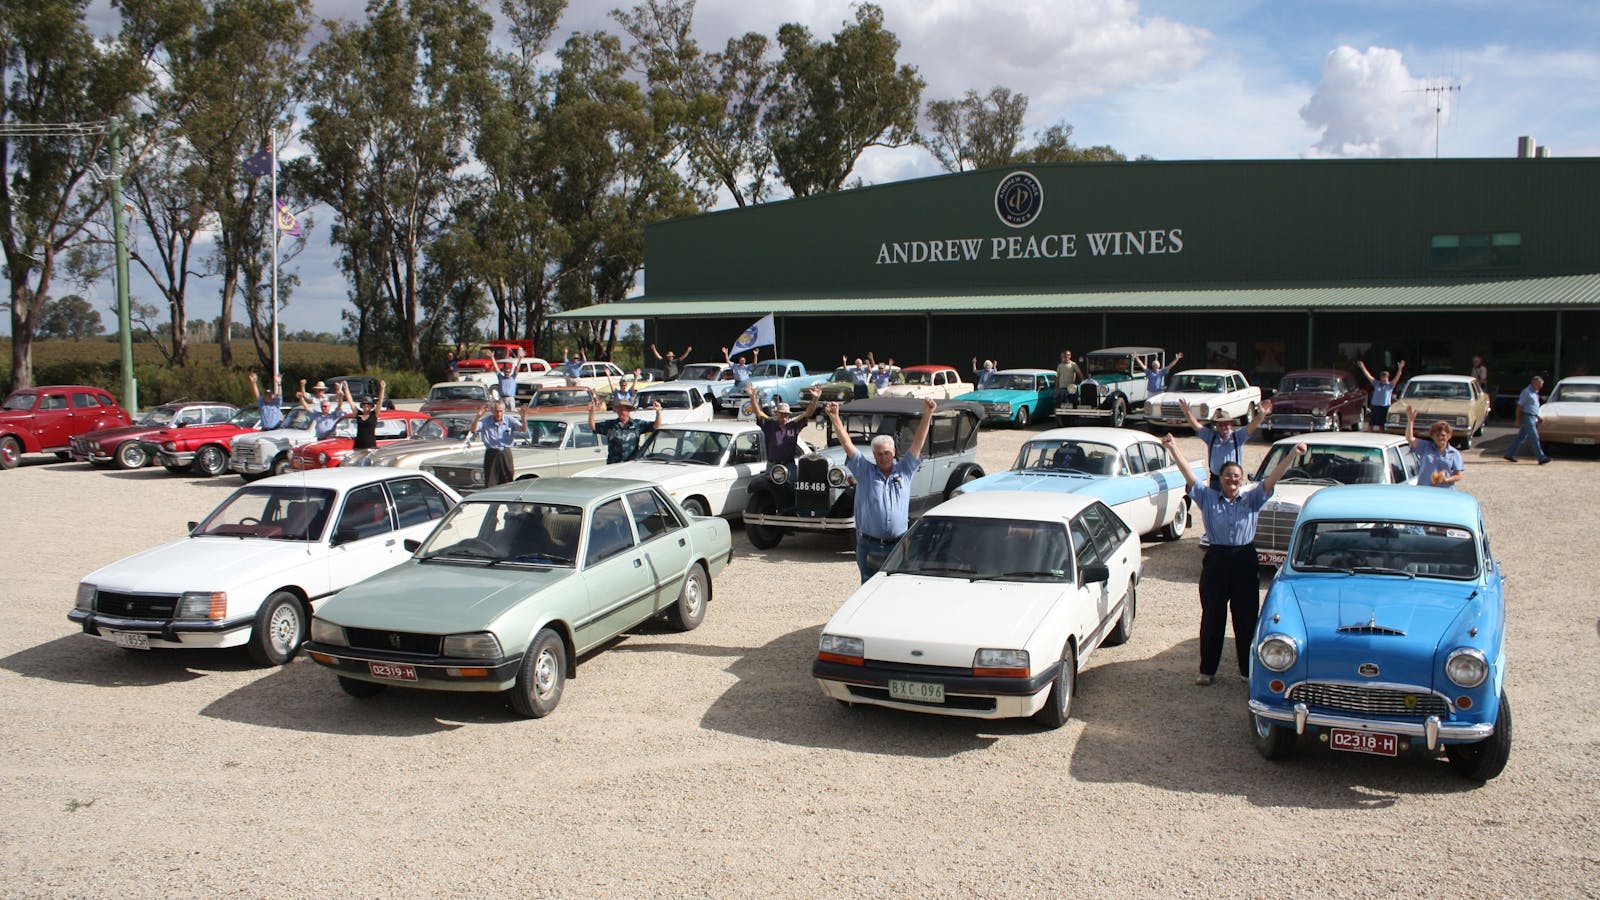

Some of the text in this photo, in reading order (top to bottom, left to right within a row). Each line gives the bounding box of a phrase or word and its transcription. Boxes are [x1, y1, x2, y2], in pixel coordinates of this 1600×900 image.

[1000, 176, 1021, 199] ANDREW
[1023, 177, 1040, 197] PEACE
[1007, 213, 1032, 222] WINES
[876, 228, 1184, 264] ANDREW PEACE WINES
